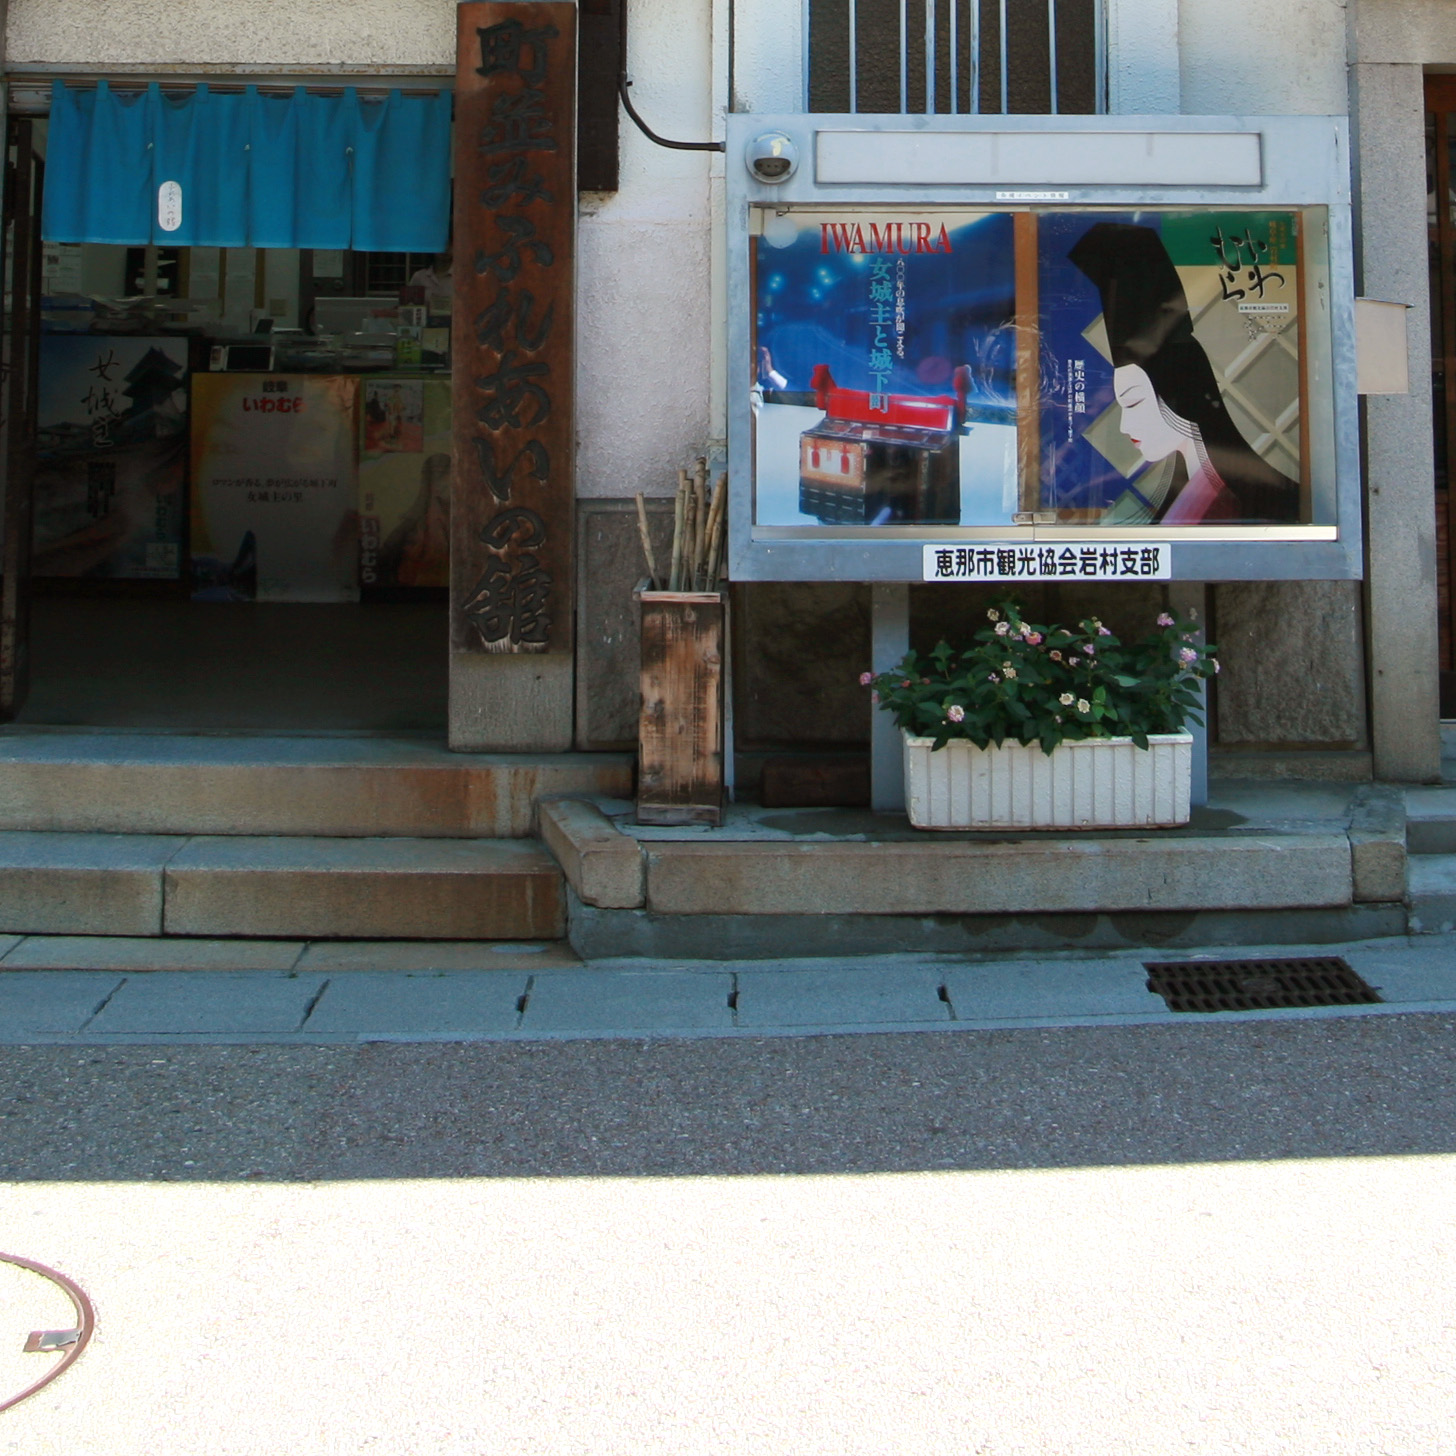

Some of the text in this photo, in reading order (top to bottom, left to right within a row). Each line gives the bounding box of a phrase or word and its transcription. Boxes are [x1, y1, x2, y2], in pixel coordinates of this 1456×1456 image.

[819, 221, 954, 255] IWAMURA
[868, 257, 894, 413] 女城主と城下町
[243, 396, 305, 414] いわむら
[934, 548, 1160, 577] 恵那市観光協会岩村支部
